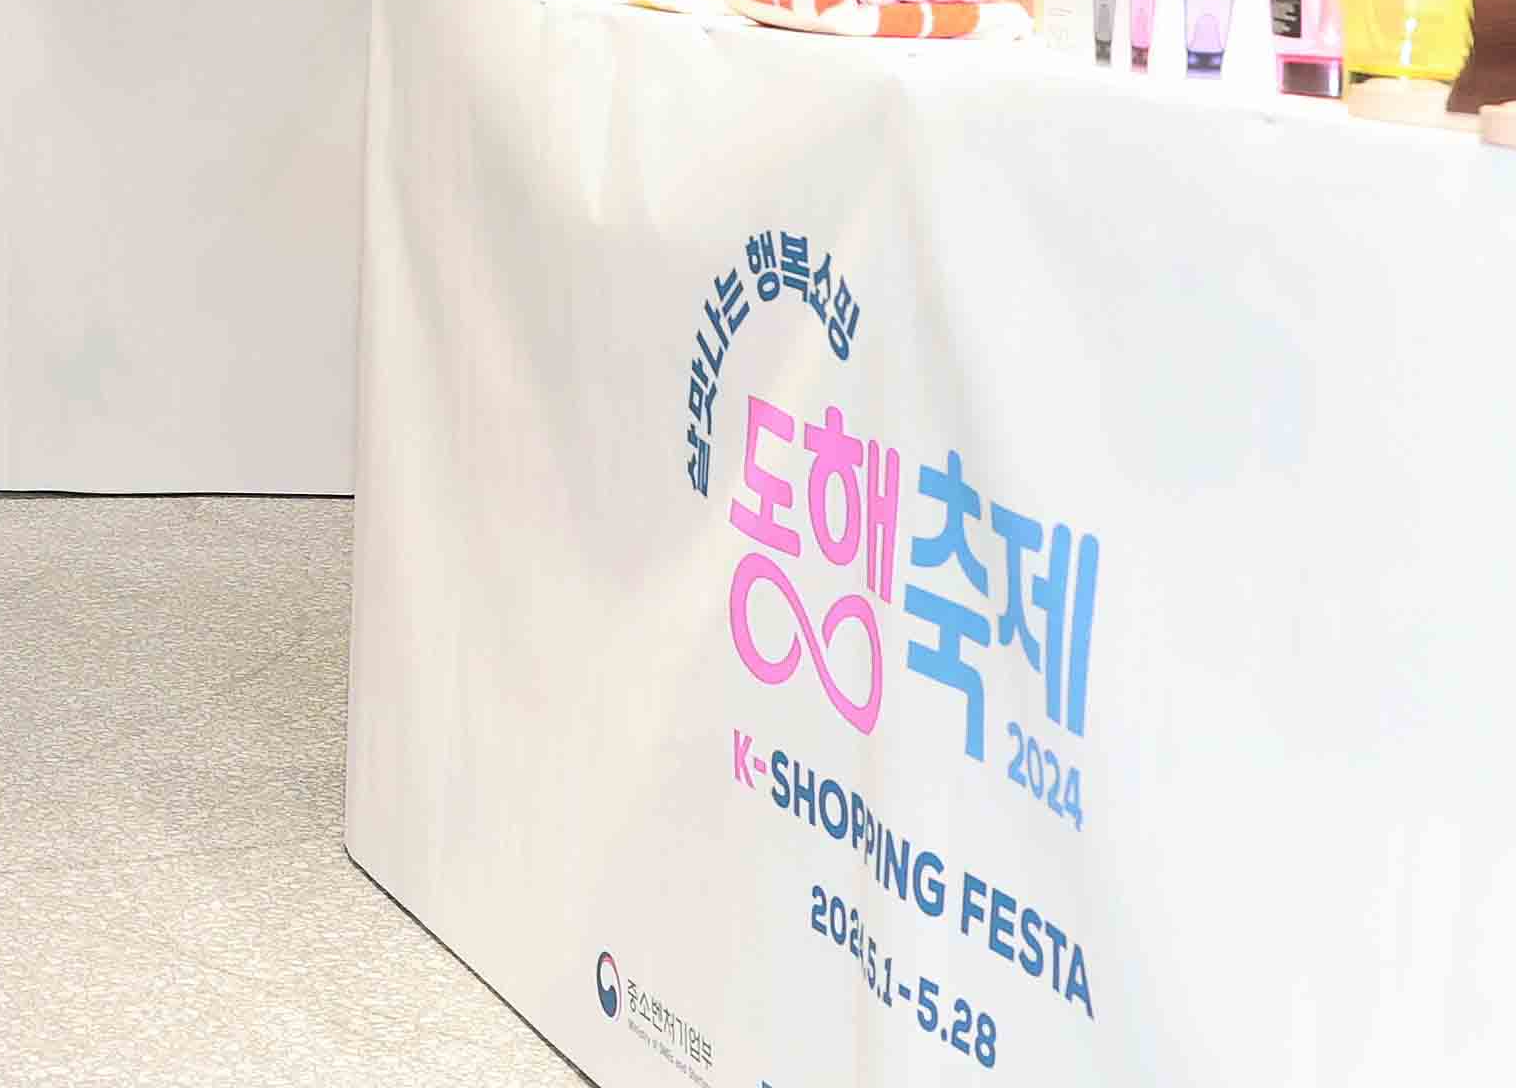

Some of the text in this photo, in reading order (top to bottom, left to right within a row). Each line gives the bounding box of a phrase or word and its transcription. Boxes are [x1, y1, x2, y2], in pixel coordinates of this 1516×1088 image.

[687, 229, 861, 498] 살맛나는 행복쇼핑
[729, 394, 1100, 762] 동행축제
[733, 727, 1095, 1021] K-SHOPPING FESTA
[1007, 720, 1083, 833] 2024
[627, 978, 714, 1070] 중소벤처기업부
